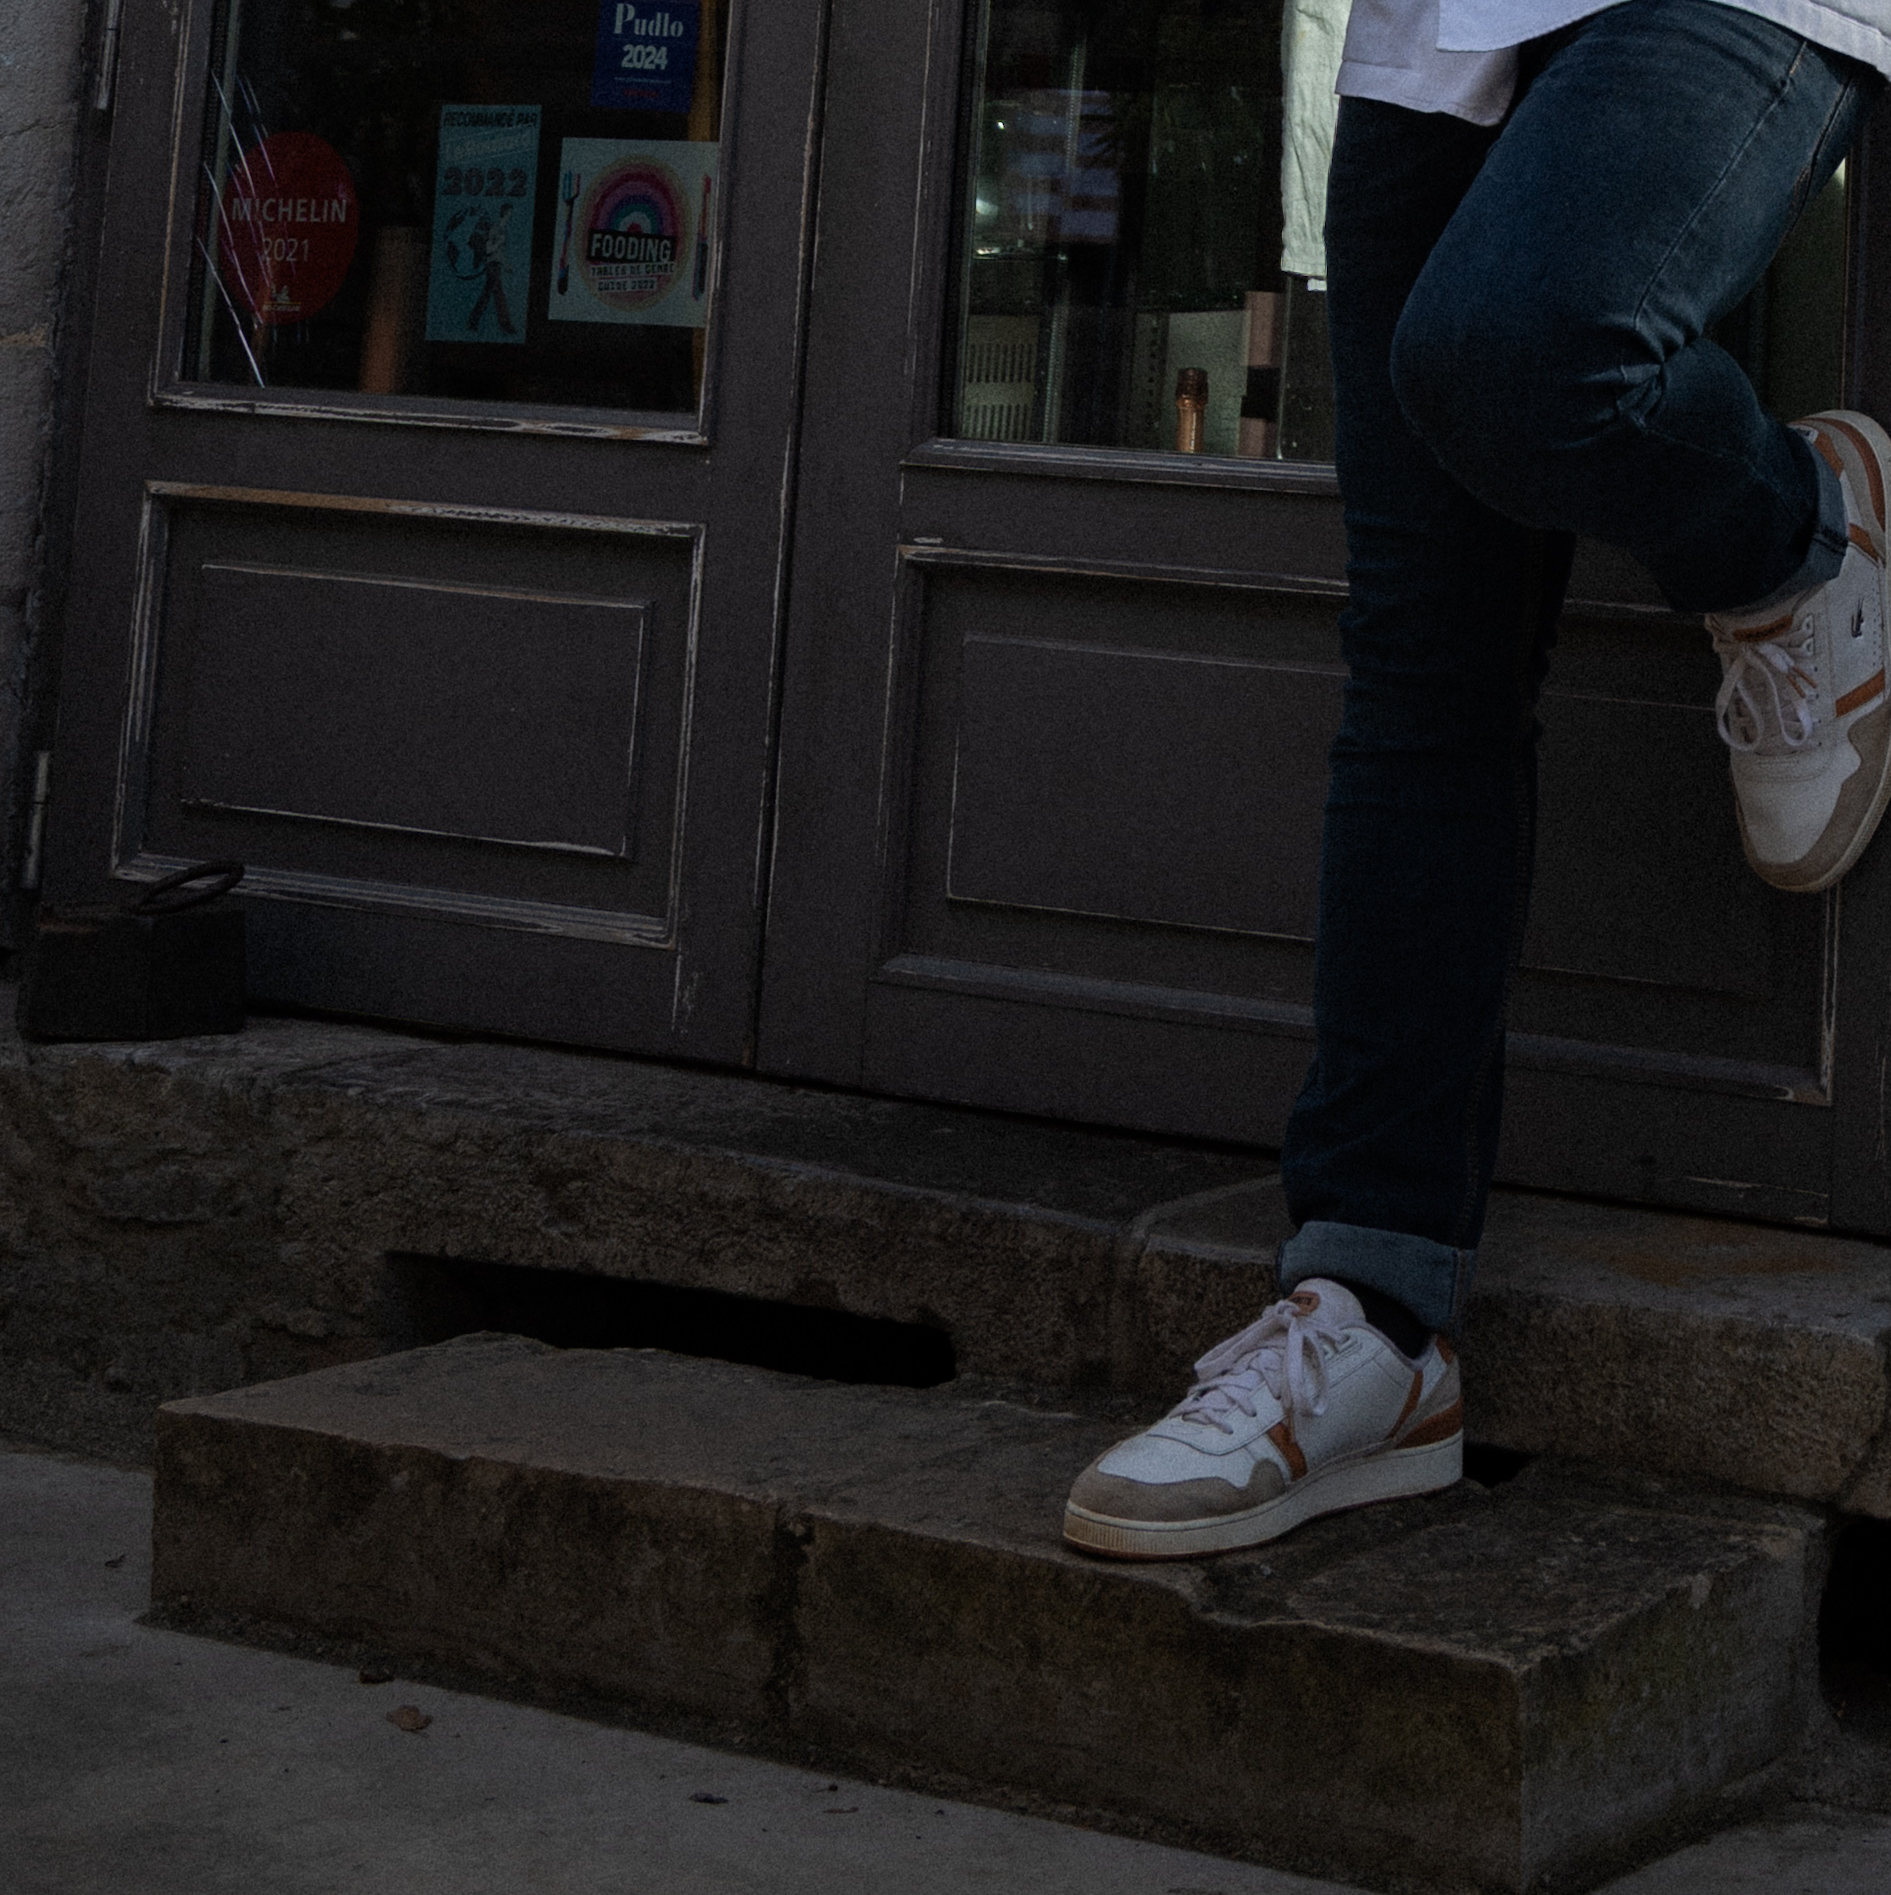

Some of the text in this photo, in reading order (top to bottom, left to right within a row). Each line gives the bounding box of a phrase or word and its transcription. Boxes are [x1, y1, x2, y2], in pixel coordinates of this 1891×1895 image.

[613, 2, 684, 38] Pudlo
[621, 44, 668, 71] 2024
[443, 109, 538, 128] RECOMMANDÉ PAR
[442, 166, 528, 197] 2022
[231, 197, 347, 223] MICHELIN
[262, 237, 309, 263] 2021
[590, 232, 673, 262] FOODING
[591, 265, 627, 276] TABLES
[629, 265, 642, 275] DE
[597, 280, 627, 292] GUIDE
